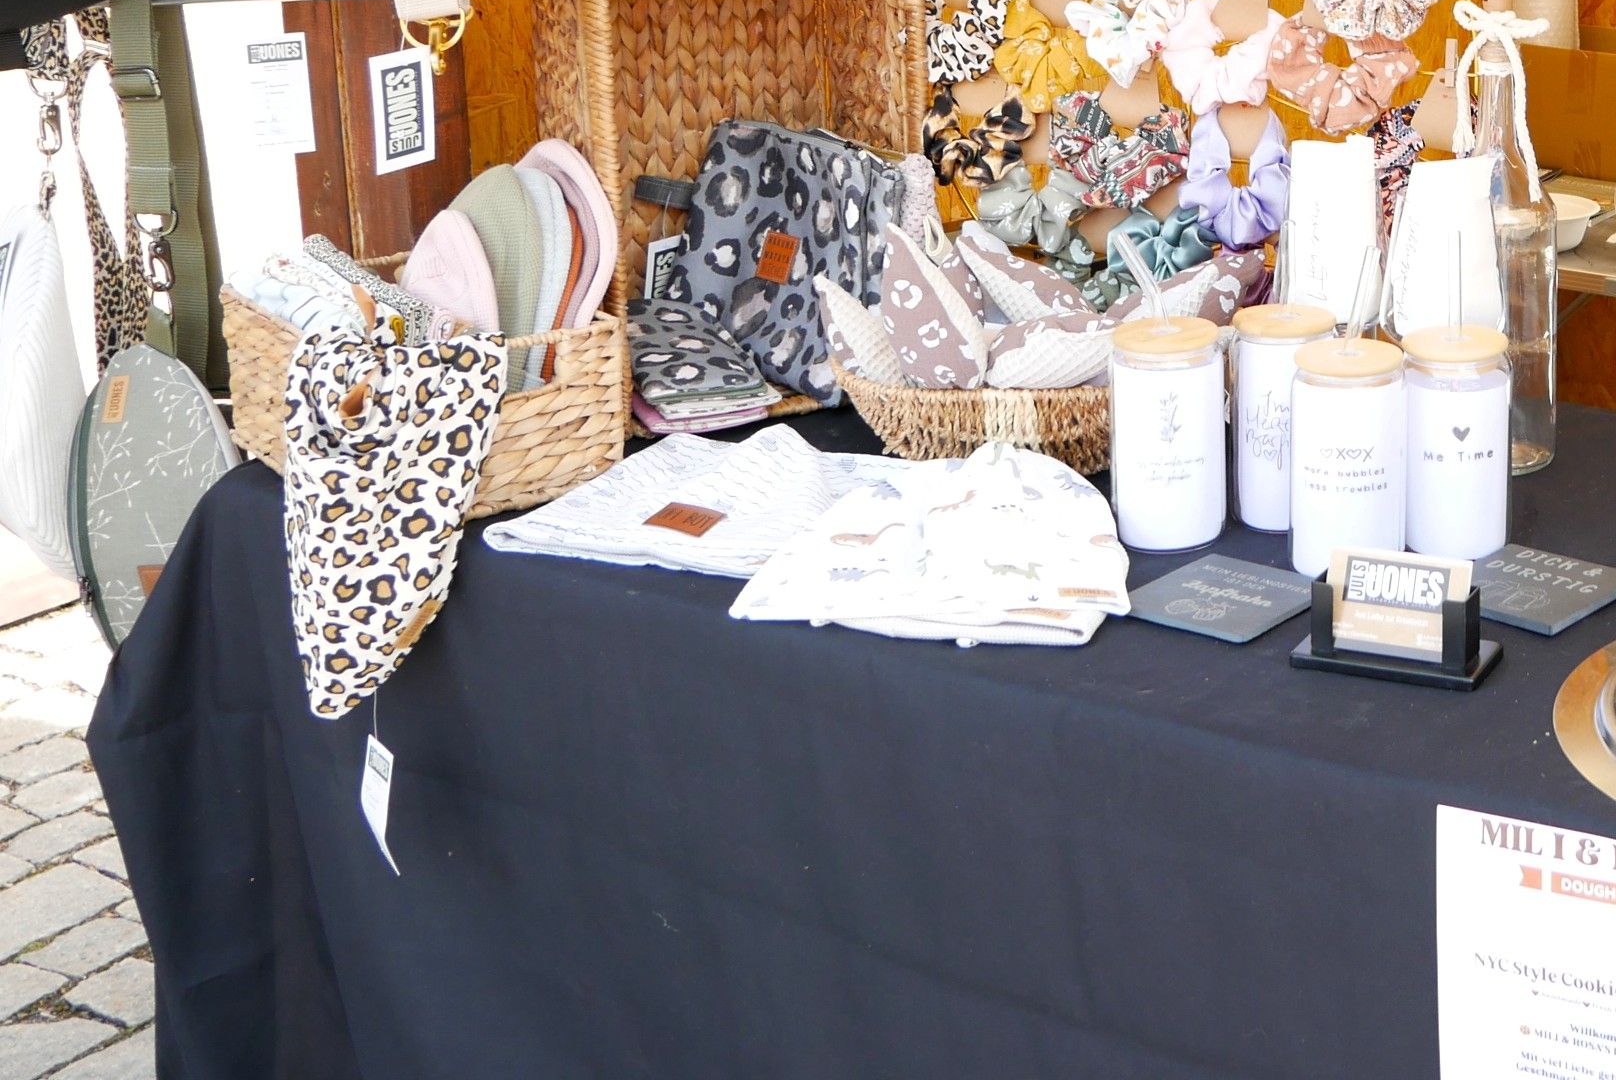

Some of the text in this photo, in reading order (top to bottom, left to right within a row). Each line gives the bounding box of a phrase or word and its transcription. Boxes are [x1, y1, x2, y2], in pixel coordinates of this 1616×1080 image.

[385, 66, 418, 138] JONES
[1423, 448, 1495, 462] Me Time
[1337, 466, 1386, 478] bubbles
[1515, 549, 1580, 571] DICK
[1349, 563, 1368, 597] JULS
[1366, 564, 1445, 607] JONES
[1485, 559, 1599, 594] DURSTIG
[1575, 837, 1601, 866] &
[1474, 951, 1510, 973] NYC
[1513, 960, 1558, 984] Style
[1520, 1049, 1538, 1063] Mit
